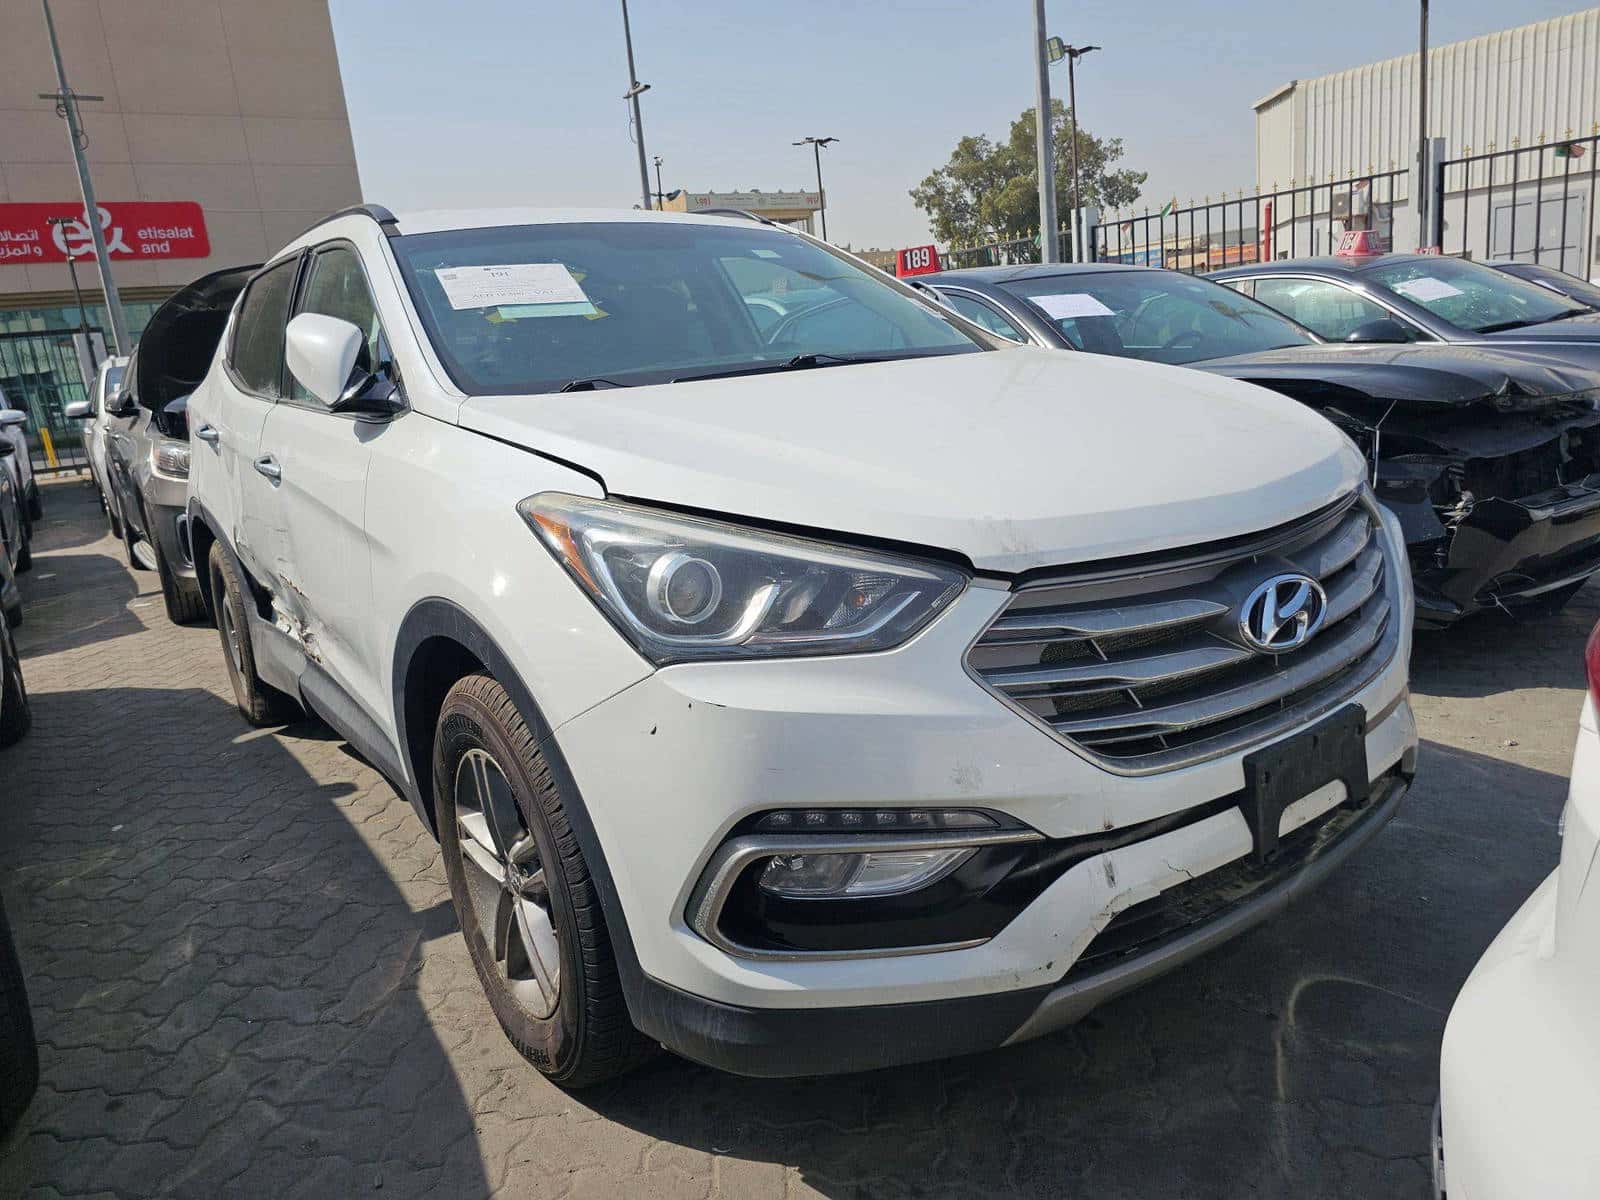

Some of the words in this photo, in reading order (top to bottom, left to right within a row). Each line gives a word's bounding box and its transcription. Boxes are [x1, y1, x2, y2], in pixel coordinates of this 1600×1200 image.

[137, 226, 195, 240] etisalat
[141, 241, 171, 254] and
[904, 247, 930, 271] 189
